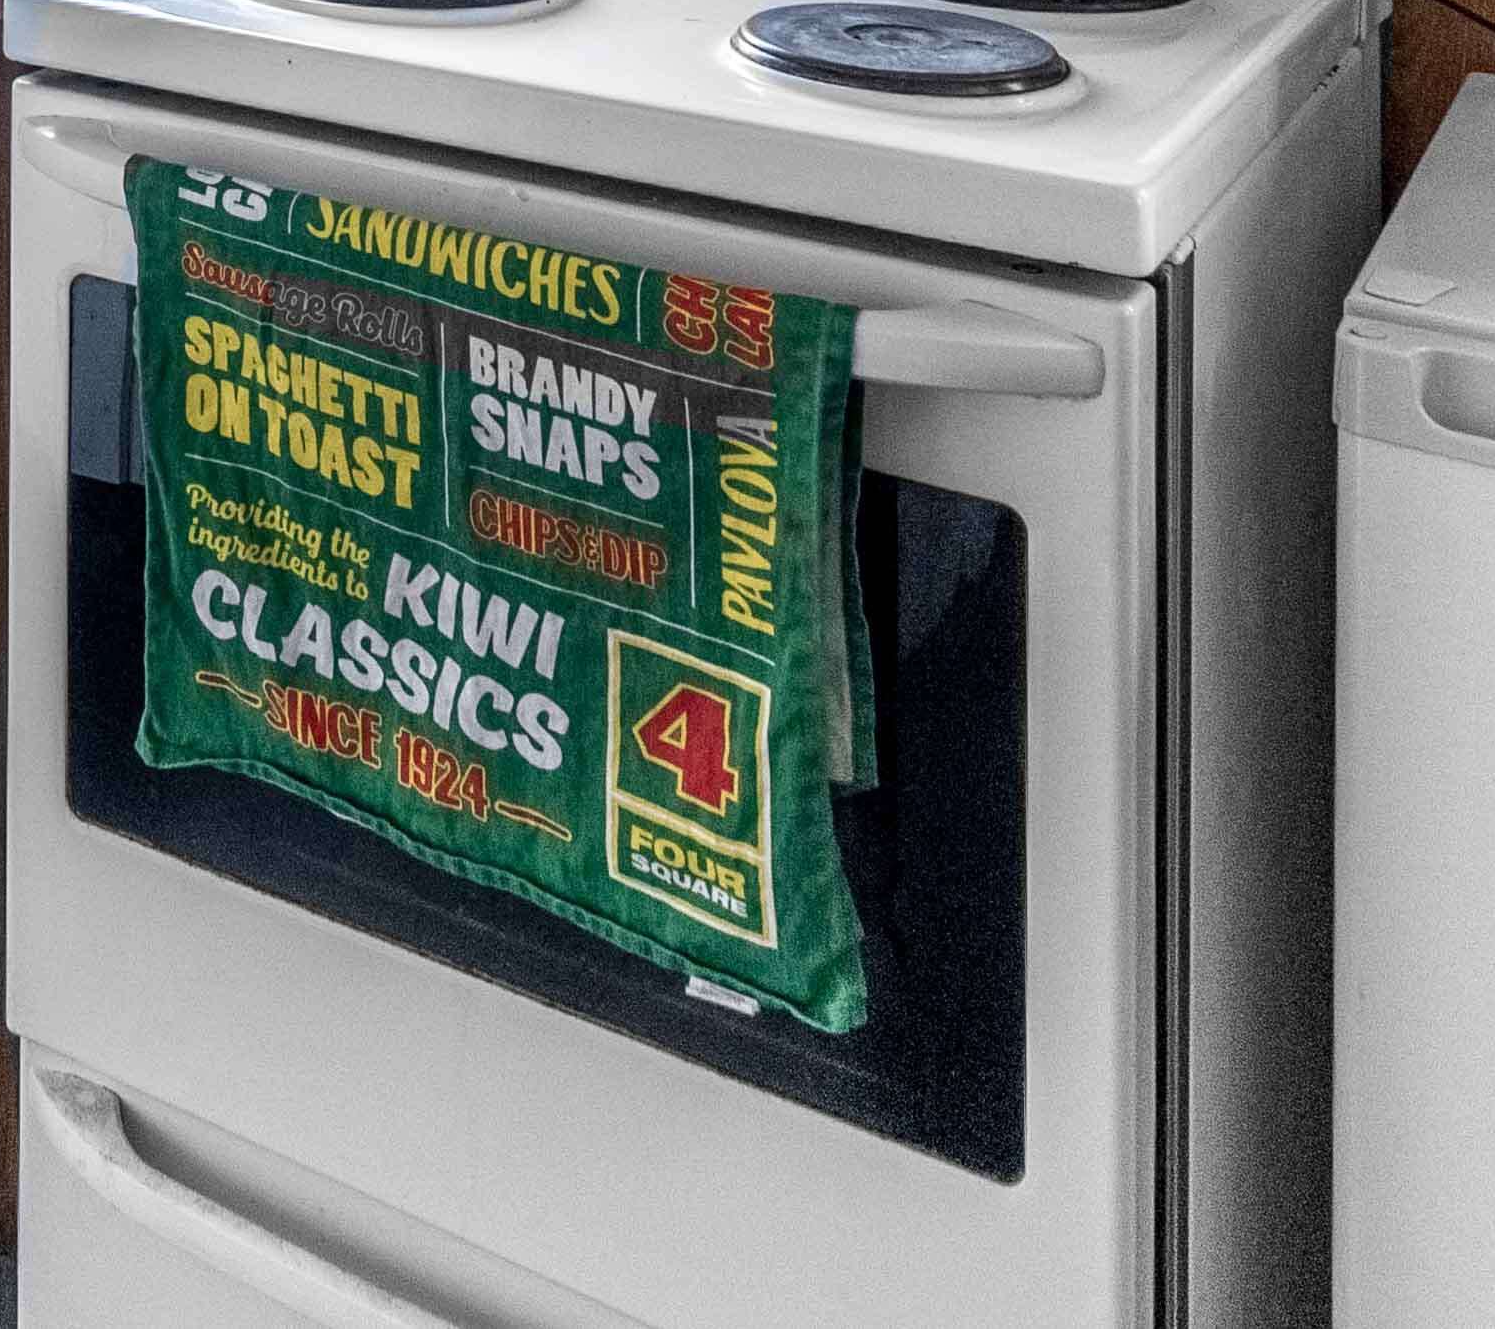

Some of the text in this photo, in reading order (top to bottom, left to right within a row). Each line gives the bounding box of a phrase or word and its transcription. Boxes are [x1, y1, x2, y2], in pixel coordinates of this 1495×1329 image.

[182, 240, 424, 356] Sausage Rolls
[307, 196, 621, 326] SANDWICHES
[184, 315, 421, 446] SPAGHETTI
[185, 373, 421, 510] ON TOAST
[469, 335, 657, 437] BRANDY
[470, 393, 661, 500] SNAPS
[186, 484, 371, 569] Providing the
[187, 517, 370, 601] ingredients to
[716, 416, 778, 636] PAVLOVA
[191, 568, 570, 771] CLASSICS
[383, 552, 566, 681] KIWI
[262, 678, 490, 822] SINCE 1924
[632, 683, 739, 817] 4
[629, 823, 747, 900] FOUR
[630, 852, 748, 919] SQUARE
